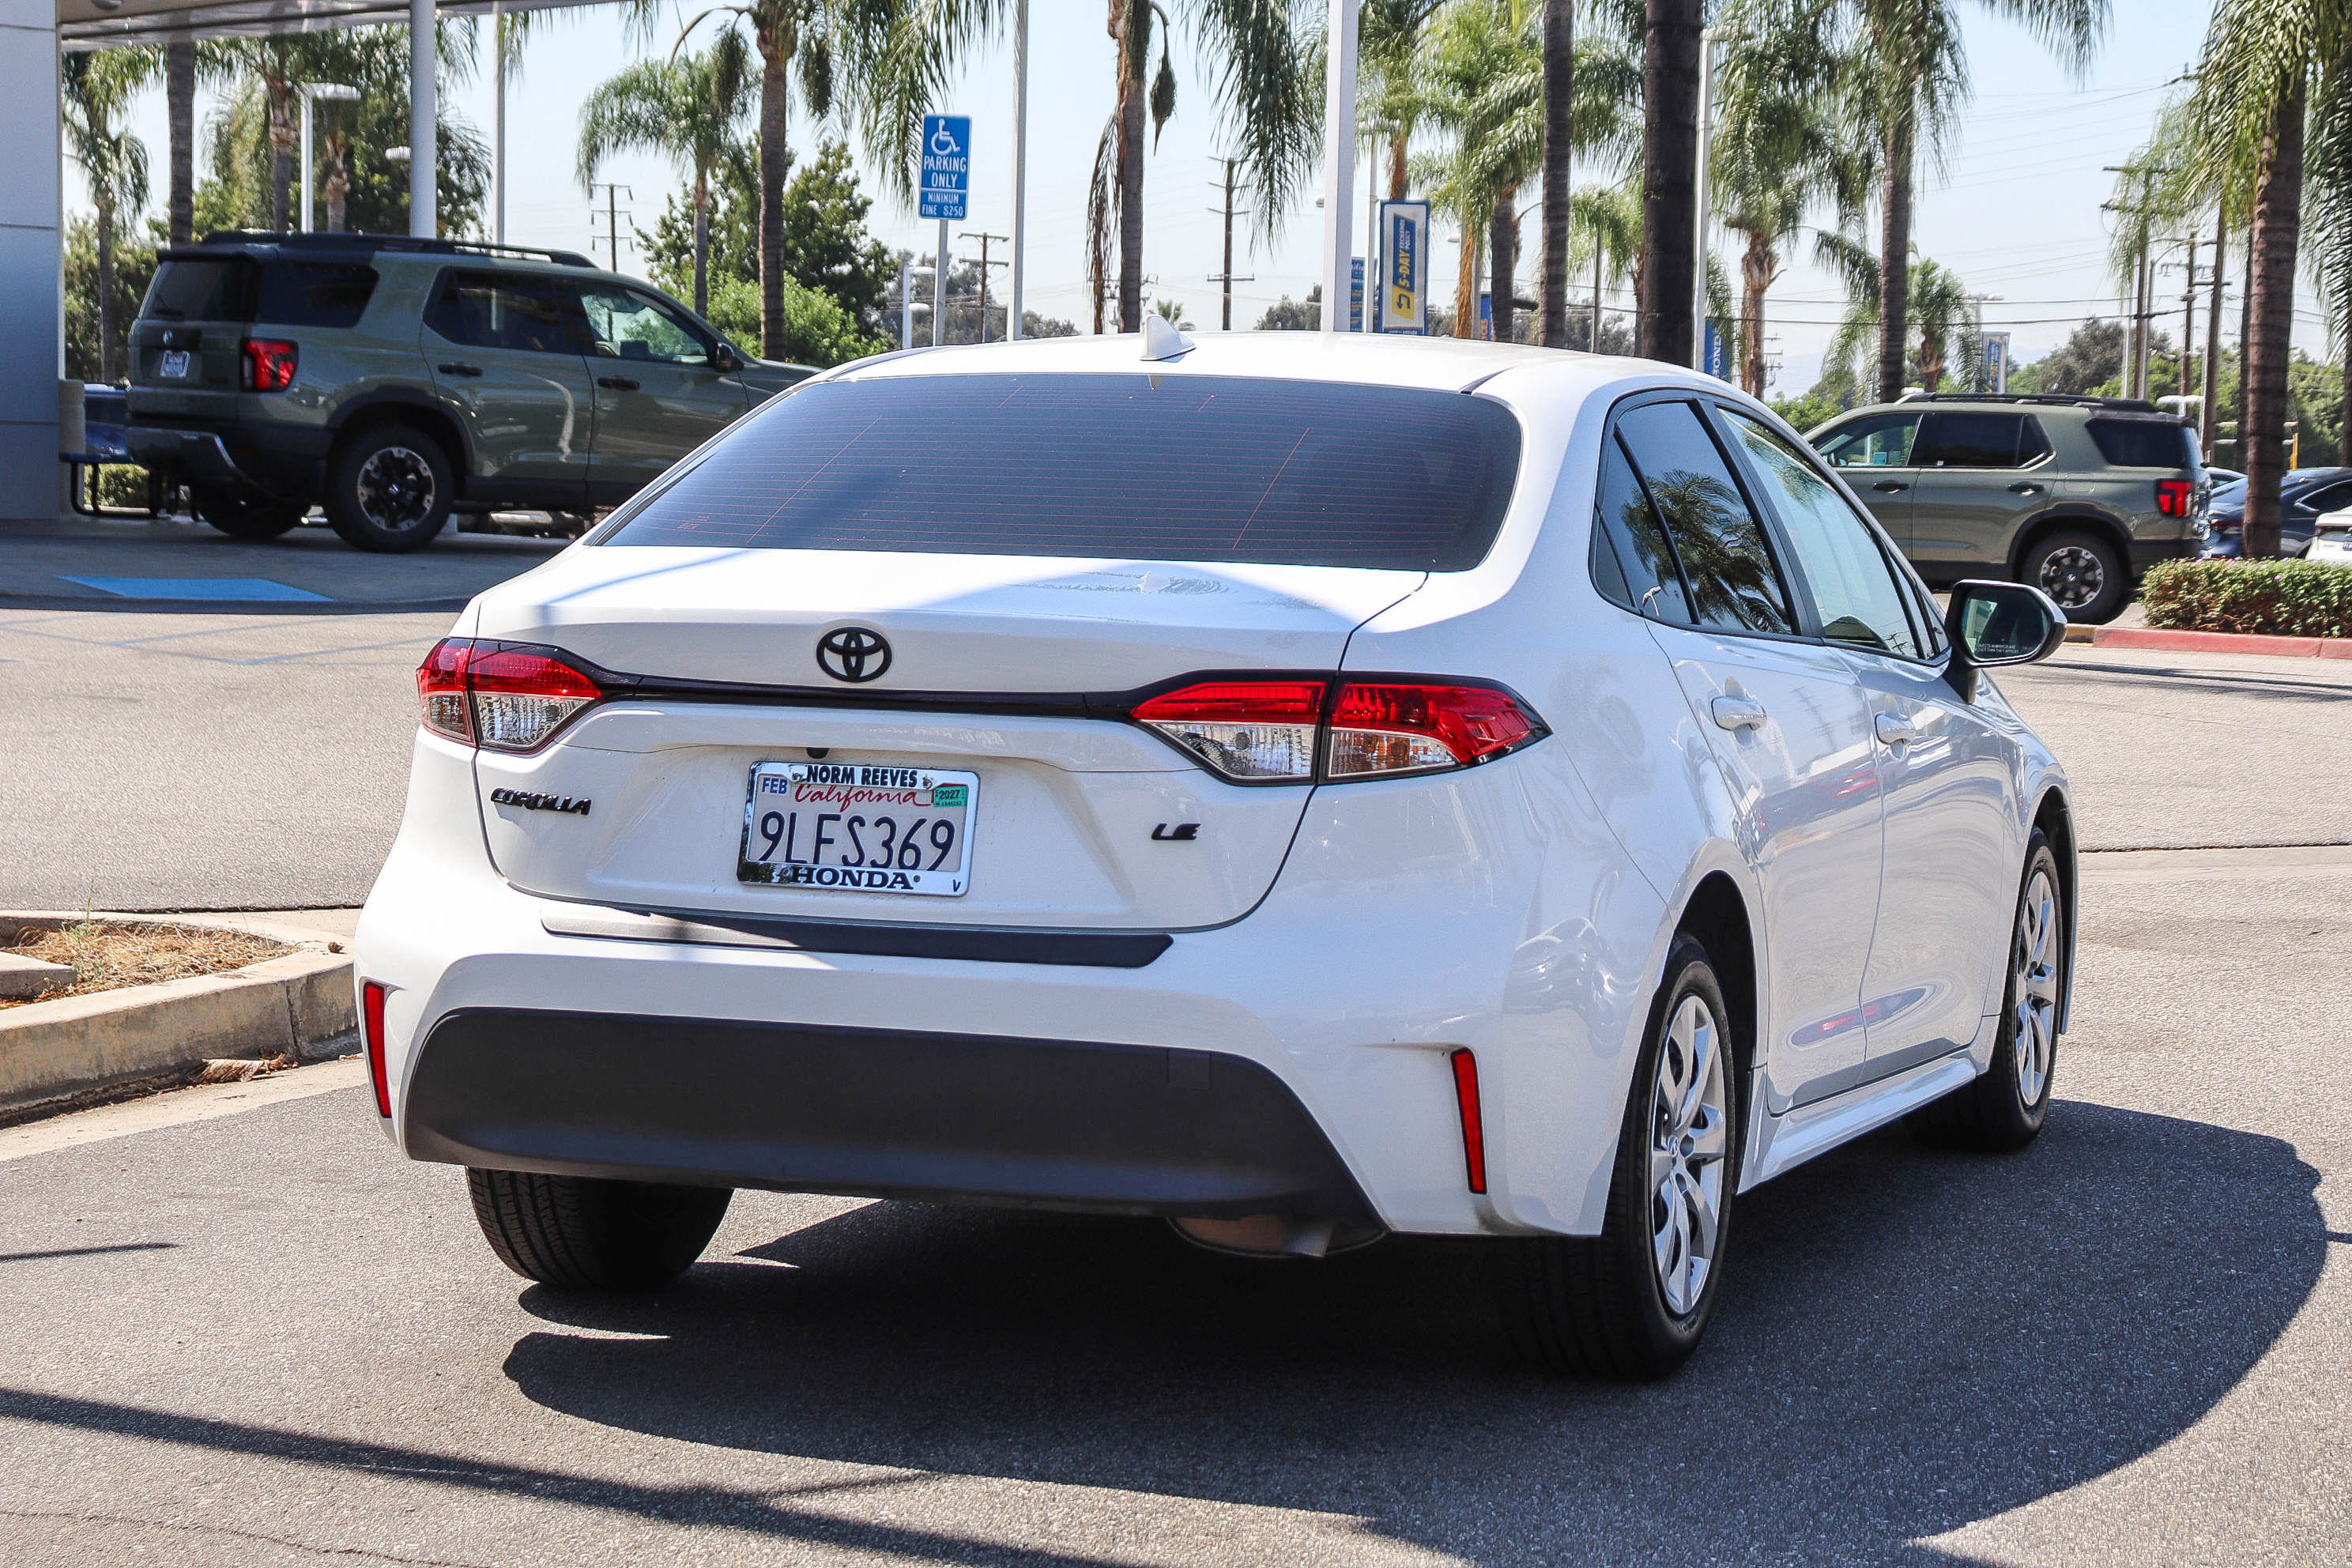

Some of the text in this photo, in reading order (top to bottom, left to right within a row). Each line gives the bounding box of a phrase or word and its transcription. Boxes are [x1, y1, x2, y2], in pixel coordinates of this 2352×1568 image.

[923, 155, 967, 173] PARKING
[931, 172, 958, 189] ONLY
[928, 191, 959, 204] MINIMUM
[922, 203, 964, 217] FINE $250
[1398, 249, 1411, 288] 5-DAY
[806, 764, 918, 788] NORM REEVES
[761, 777, 788, 794] FEB
[938, 789, 961, 800] 2027
[490, 788, 592, 816] COROLLA
[794, 784, 932, 812] California
[758, 810, 956, 871] 9LFS369
[1151, 823, 1201, 840] LE
[790, 866, 914, 890] HONDA
